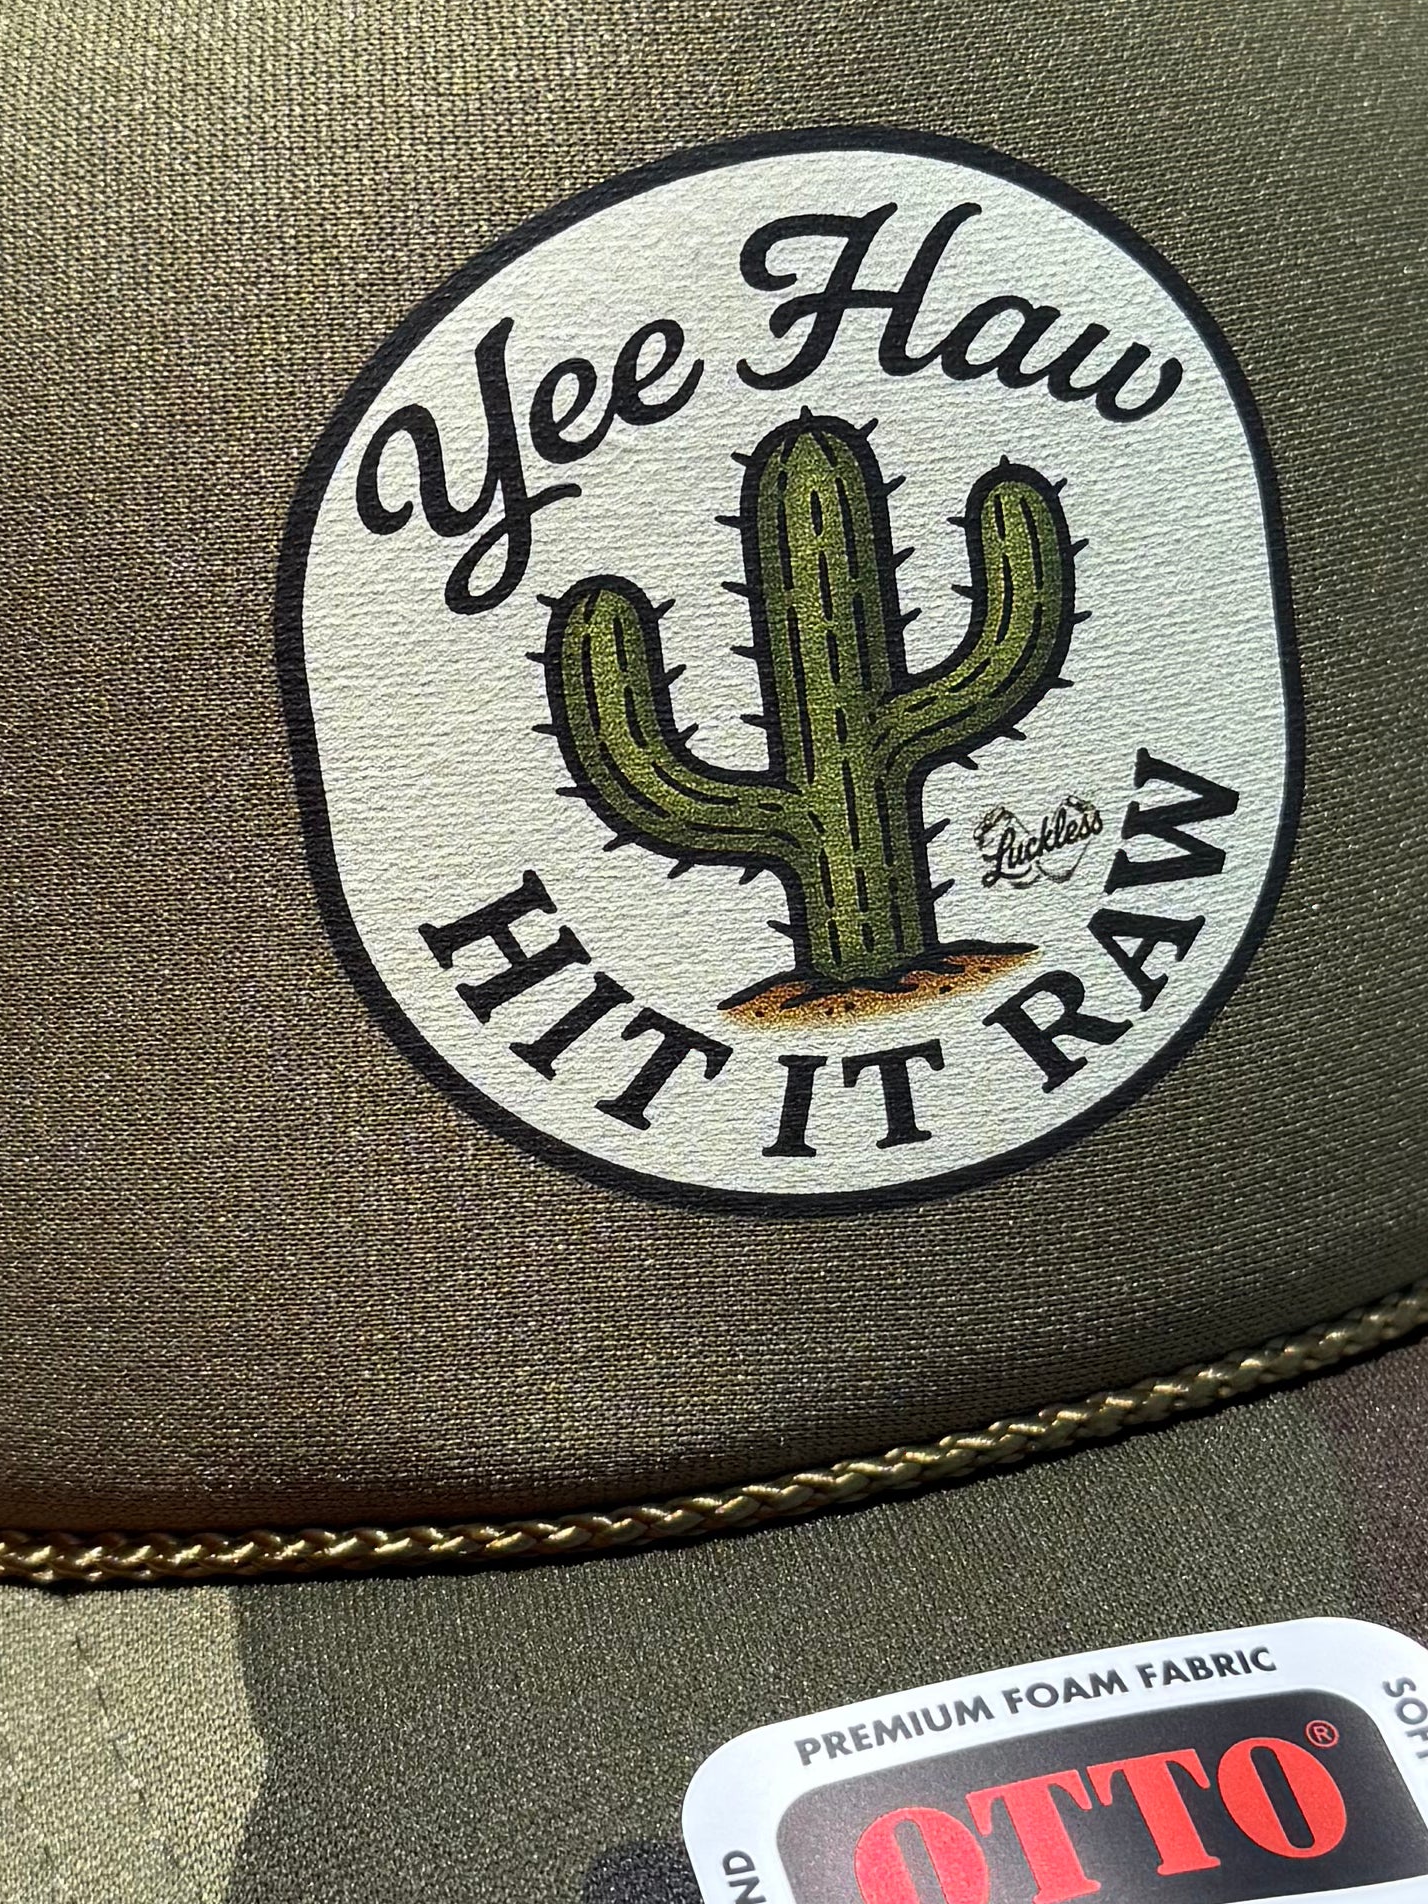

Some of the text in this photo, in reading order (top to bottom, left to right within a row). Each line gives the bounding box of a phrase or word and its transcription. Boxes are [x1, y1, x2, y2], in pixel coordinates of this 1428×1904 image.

[354, 201, 1184, 616] Yee Haw
[417, 746, 1240, 1159] HIT IT RAW
[794, 1645, 1278, 1767] PREMIUM FOAM FABRIC
